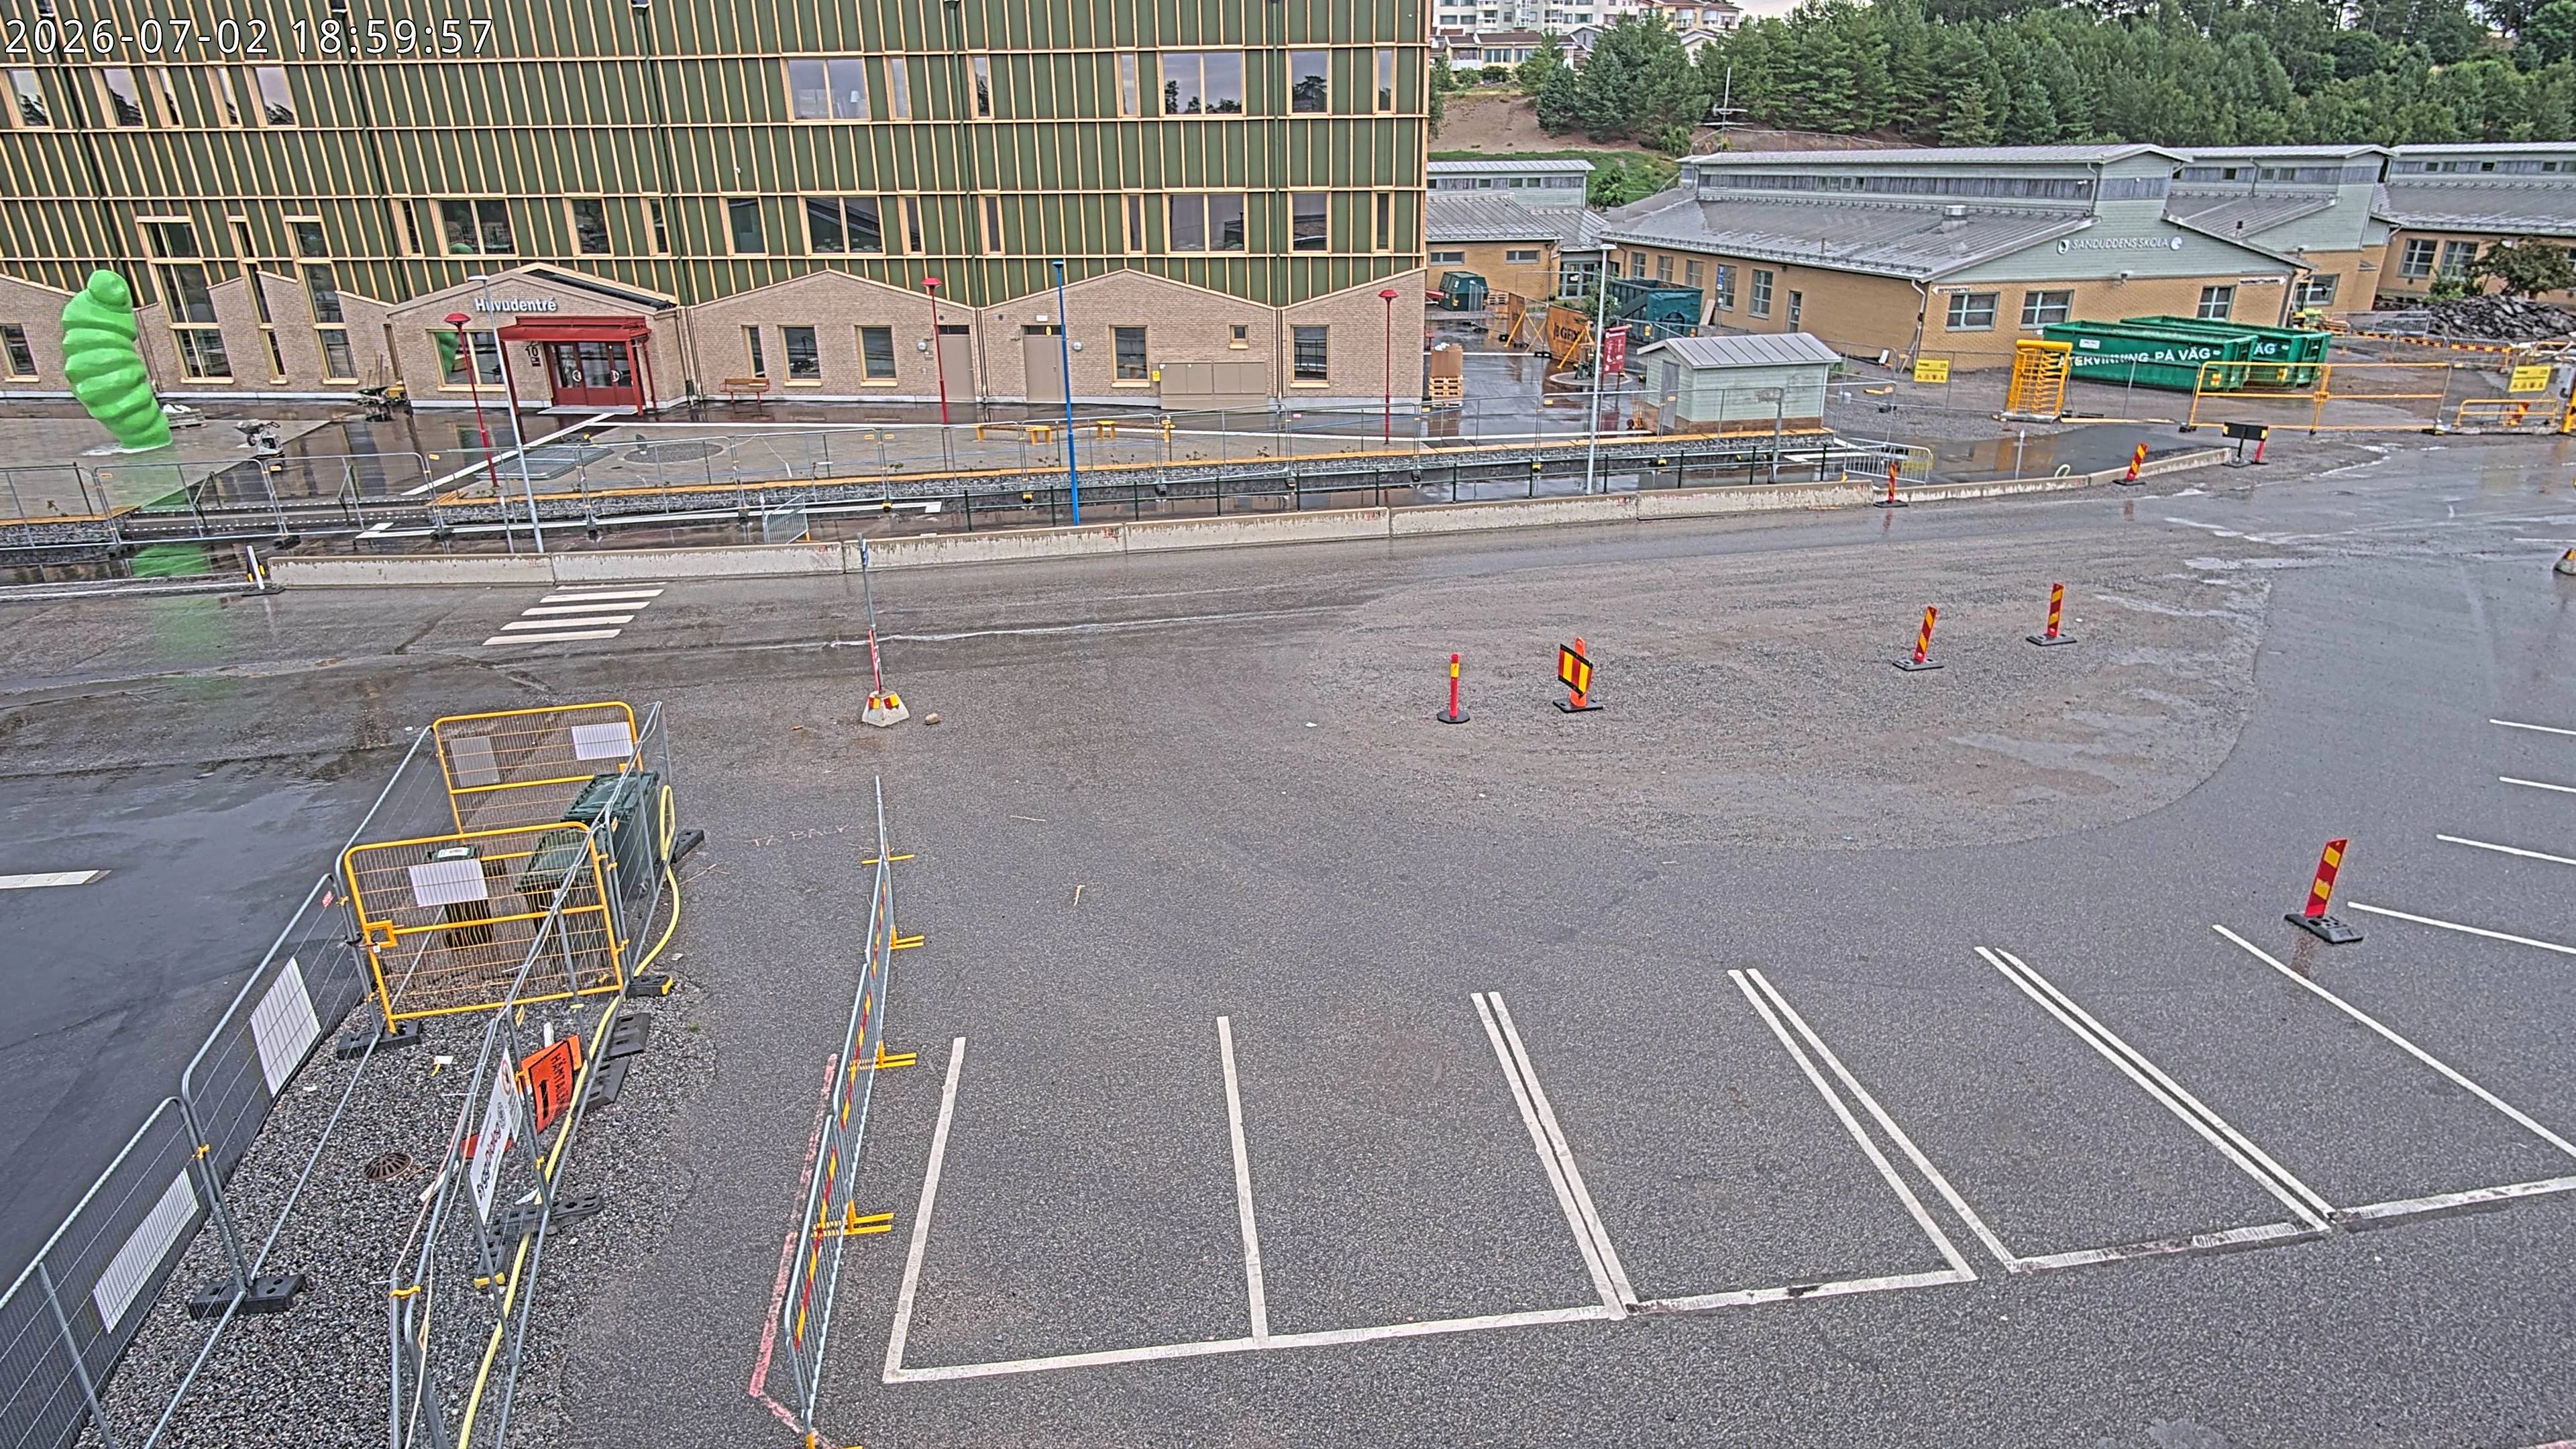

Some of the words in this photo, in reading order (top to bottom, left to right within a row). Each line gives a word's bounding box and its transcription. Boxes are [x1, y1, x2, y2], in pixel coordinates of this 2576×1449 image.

[474, 296, 557, 311] Huvudentré
[525, 346, 539, 357] 10
[2155, 348, 2175, 362] PÅ
[2178, 346, 2210, 361] VÄG
[2253, 341, 2277, 355] ÄG
